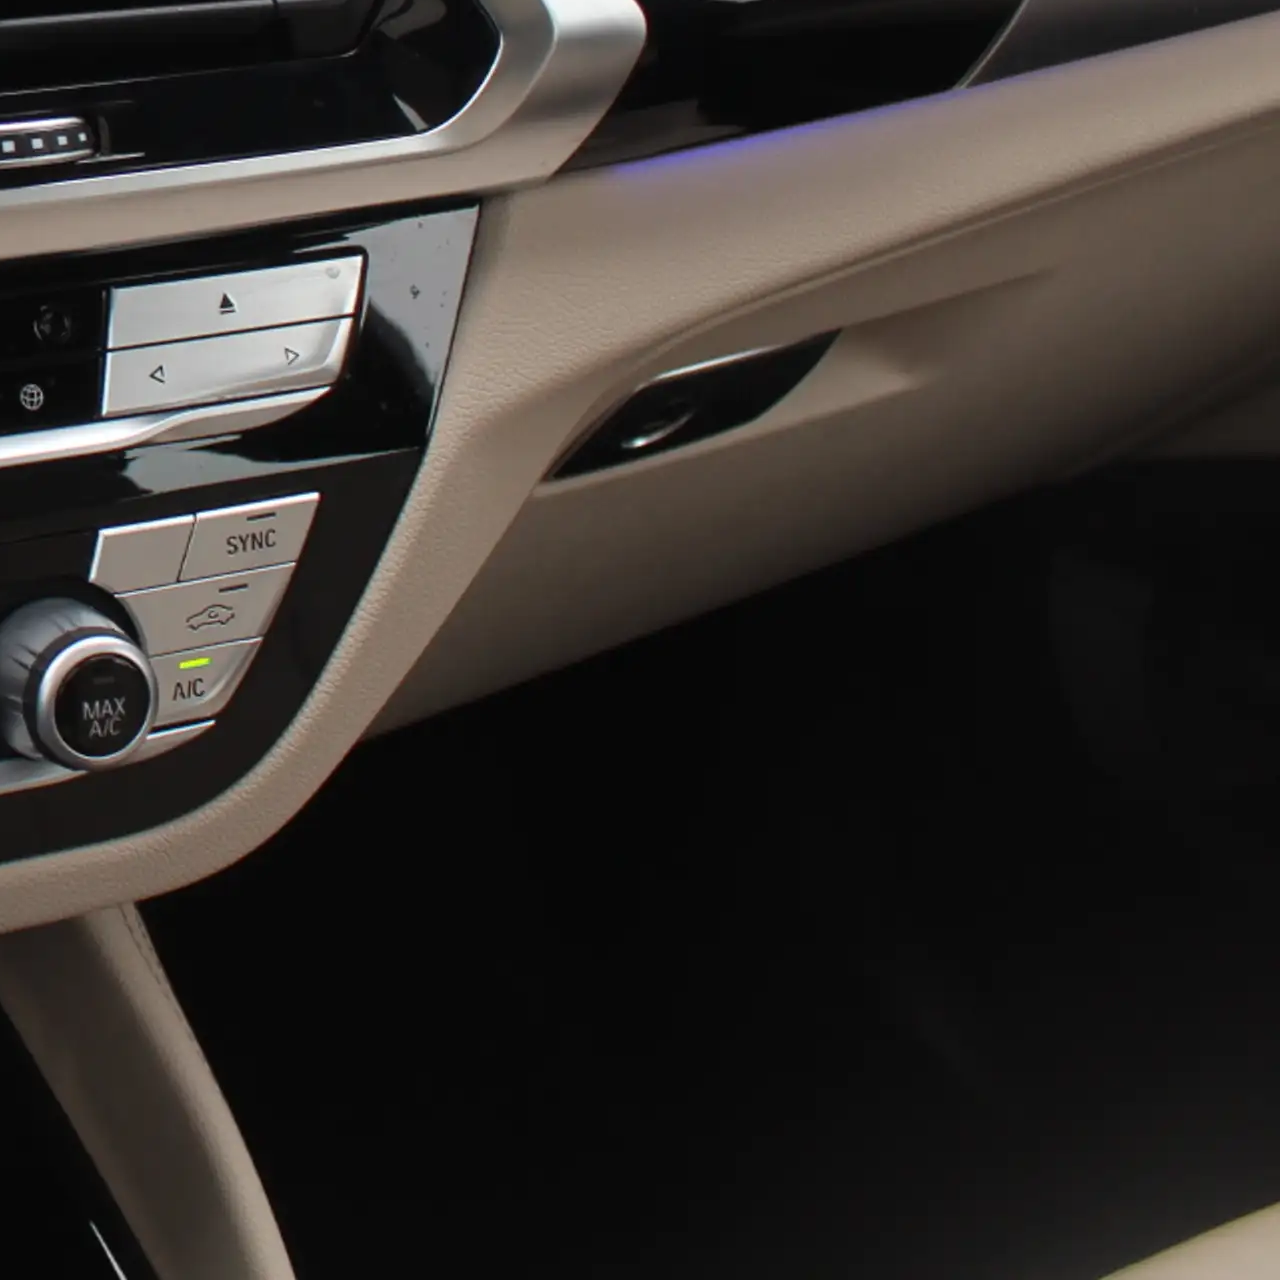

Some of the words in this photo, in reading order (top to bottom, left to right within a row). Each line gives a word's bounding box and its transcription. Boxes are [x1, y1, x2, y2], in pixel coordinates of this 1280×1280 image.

[225, 528, 277, 555] SYNC
[171, 677, 206, 702] A/C
[81, 696, 126, 721] MAX
[88, 716, 122, 738] A/C
